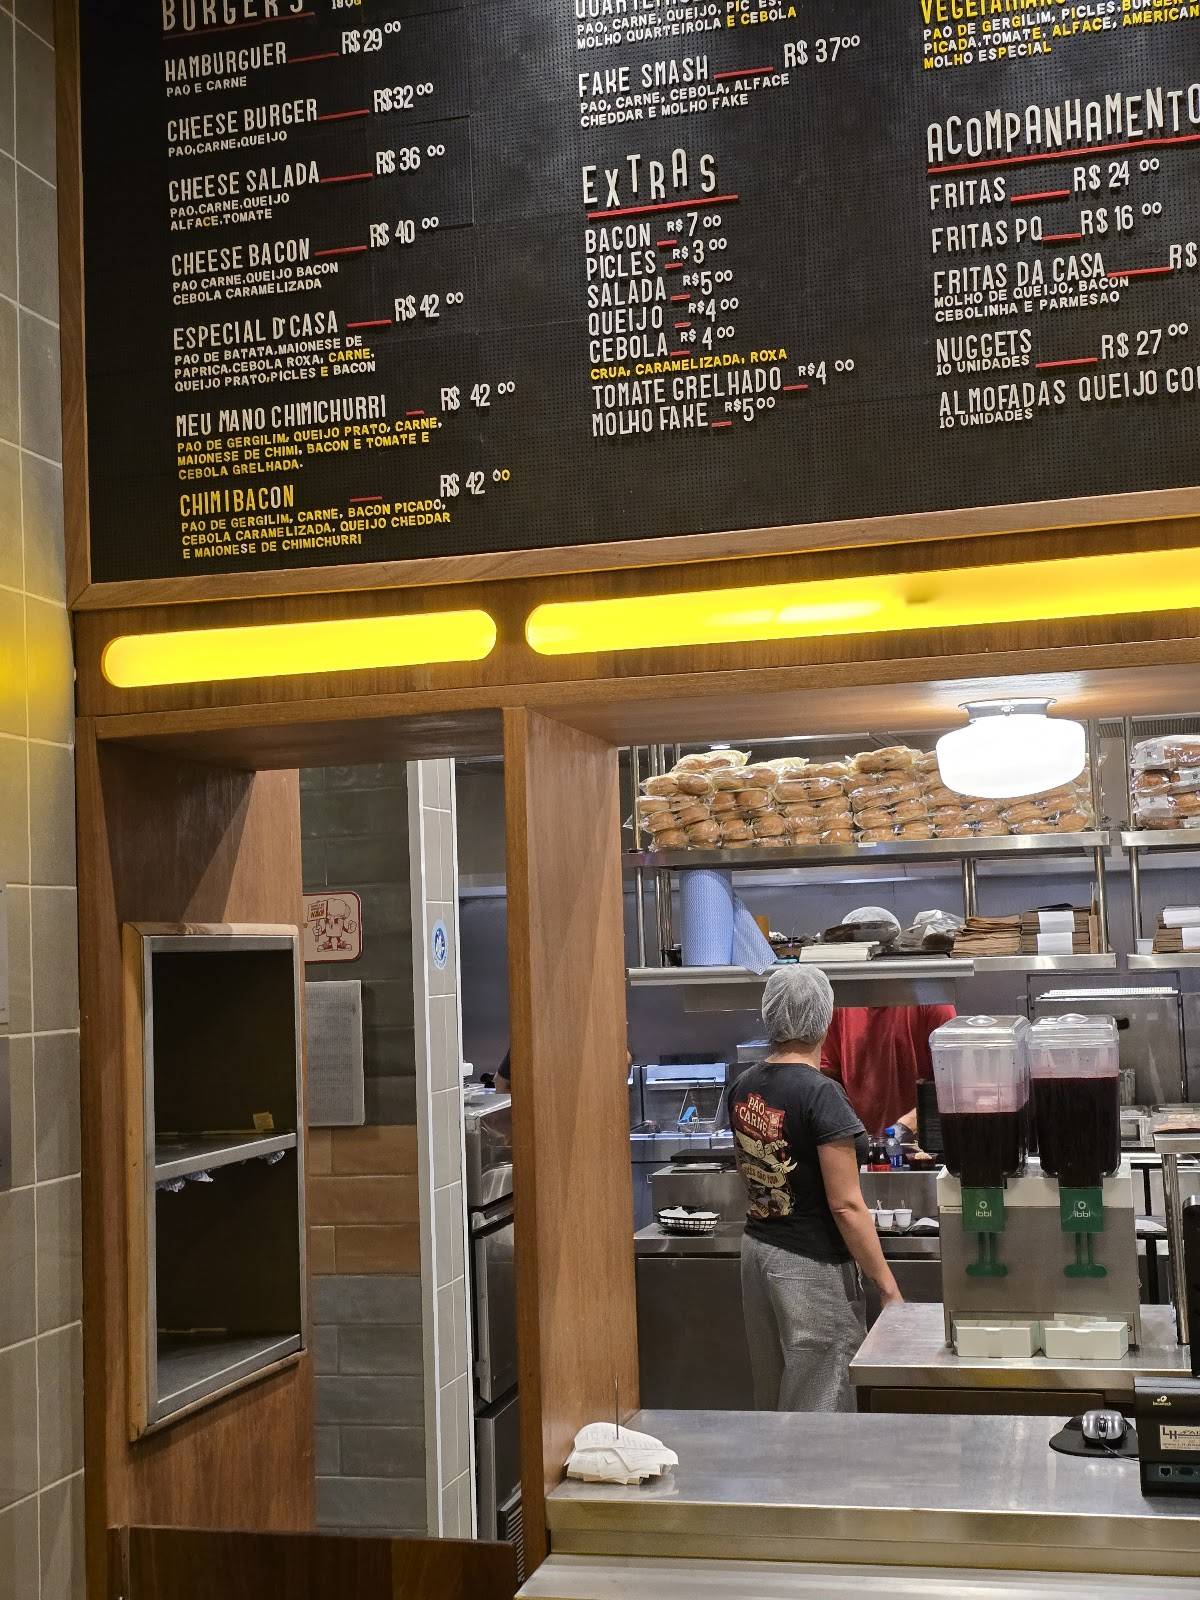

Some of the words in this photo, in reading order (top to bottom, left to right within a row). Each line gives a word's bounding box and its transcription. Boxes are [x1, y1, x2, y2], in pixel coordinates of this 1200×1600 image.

[727, 0, 752, 15] PIC
[576, 32, 621, 49] MOLHO
[626, 18, 721, 41] QUARTEIROLA
[727, 15, 735, 27] E
[741, 7, 796, 24] CEBOLA
[924, 26, 952, 40] PAO
[958, 23, 975, 37] DE
[165, 42, 286, 81] HAMBURGUER
[924, 52, 973, 69] MOLHO
[979, 41, 1051, 62] ESPECIAL
[167, 85, 190, 97] PAO
[195, 83, 201, 93] E
[207, 76, 246, 90] CARNE
[578, 67, 629, 97] FAKE
[642, 55, 707, 87] SMASH
[735, 73, 789, 91] ALFACE
[168, 111, 238, 141] CHEESE
[244, 99, 317, 130] BURGER
[580, 109, 643, 127] CHEDDAR
[649, 106, 656, 118] E
[662, 99, 707, 115] MOLHO
[712, 94, 748, 109] FAKE
[169, 172, 239, 202] CHEESE
[246, 161, 319, 192] SALADA
[930, 177, 1005, 210] FRITAS
[585, 223, 650, 253] BACON
[932, 220, 1007, 253] FRITAS
[1016, 216, 1043, 242] PQ
[172, 246, 243, 276] CHEESE
[249, 238, 309, 266] BACON
[586, 250, 656, 281] PICLES
[173, 280, 197, 292] PAO
[297, 262, 338, 277] BACON
[934, 263, 1007, 296] FRITAS
[1017, 260, 1044, 287] DA
[1053, 253, 1106, 283] CASA
[173, 290, 221, 305] CEBOLA
[226, 278, 322, 298] CARAMELIZADA
[588, 276, 666, 308] SALADA
[935, 292, 983, 308] MOLHO
[989, 289, 1007, 303] DE
[1079, 276, 1128, 293] BACON
[935, 303, 1018, 322] CEBOLINHA
[1024, 300, 1032, 312] E
[1040, 291, 1119, 310] PARMESAO
[174, 319, 266, 350] ESPECIAL
[273, 311, 338, 339] D'CASA
[589, 305, 662, 336] QUEIJO
[175, 354, 199, 365] PAO
[204, 352, 219, 363] DE
[346, 335, 362, 347] DE
[590, 332, 668, 363] CEBOLA
[751, 349, 787, 363] ROXA
[937, 329, 1031, 364] NUGGETS
[175, 378, 220, 391] QUEIJO
[321, 366, 328, 376] E
[333, 361, 375, 375] BACON
[937, 362, 951, 376] 10
[957, 355, 1029, 373] UNIDADES
[592, 379, 665, 409] TOMATE
[673, 367, 782, 400] GRELHADO
[940, 380, 1065, 417] ALMOFADAS
[1079, 370, 1157, 401] QUEIJO
[177, 413, 211, 437] MEU
[219, 408, 265, 432] MANO
[272, 394, 385, 428] CHIMICHURRI
[592, 409, 652, 437] MOLHO
[660, 403, 708, 430] FAKE
[940, 415, 955, 428] 10
[960, 408, 1033, 426] UNIDADES
[178, 441, 201, 452] PAO
[207, 439, 222, 450] DE
[294, 427, 341, 443] QUEIJO
[178, 451, 238, 466] MAIONESE
[245, 449, 259, 459] DE
[307, 440, 348, 453] BACON
[354, 439, 361, 449] E
[366, 433, 414, 448] TOMATE
[422, 432, 429, 442] E
[179, 466, 228, 480] CEBOLA
[180, 485, 293, 516] CHIMIBACON
[182, 521, 205, 532] PAO
[211, 519, 226, 530] DE
[347, 504, 391, 521] BACON
[182, 532, 231, 545] CEBOLA
[340, 518, 386, 531] QUEIJO
[391, 512, 450, 527] CHEDDAR
[183, 549, 190, 558] E
[195, 543, 256, 557] MAIONESE
[262, 541, 276, 552] DE
[282, 534, 361, 550] CHIMICHURRI
[740, 1106, 768, 1137] CARNE
[748, 1096, 765, 1116] PÃO
